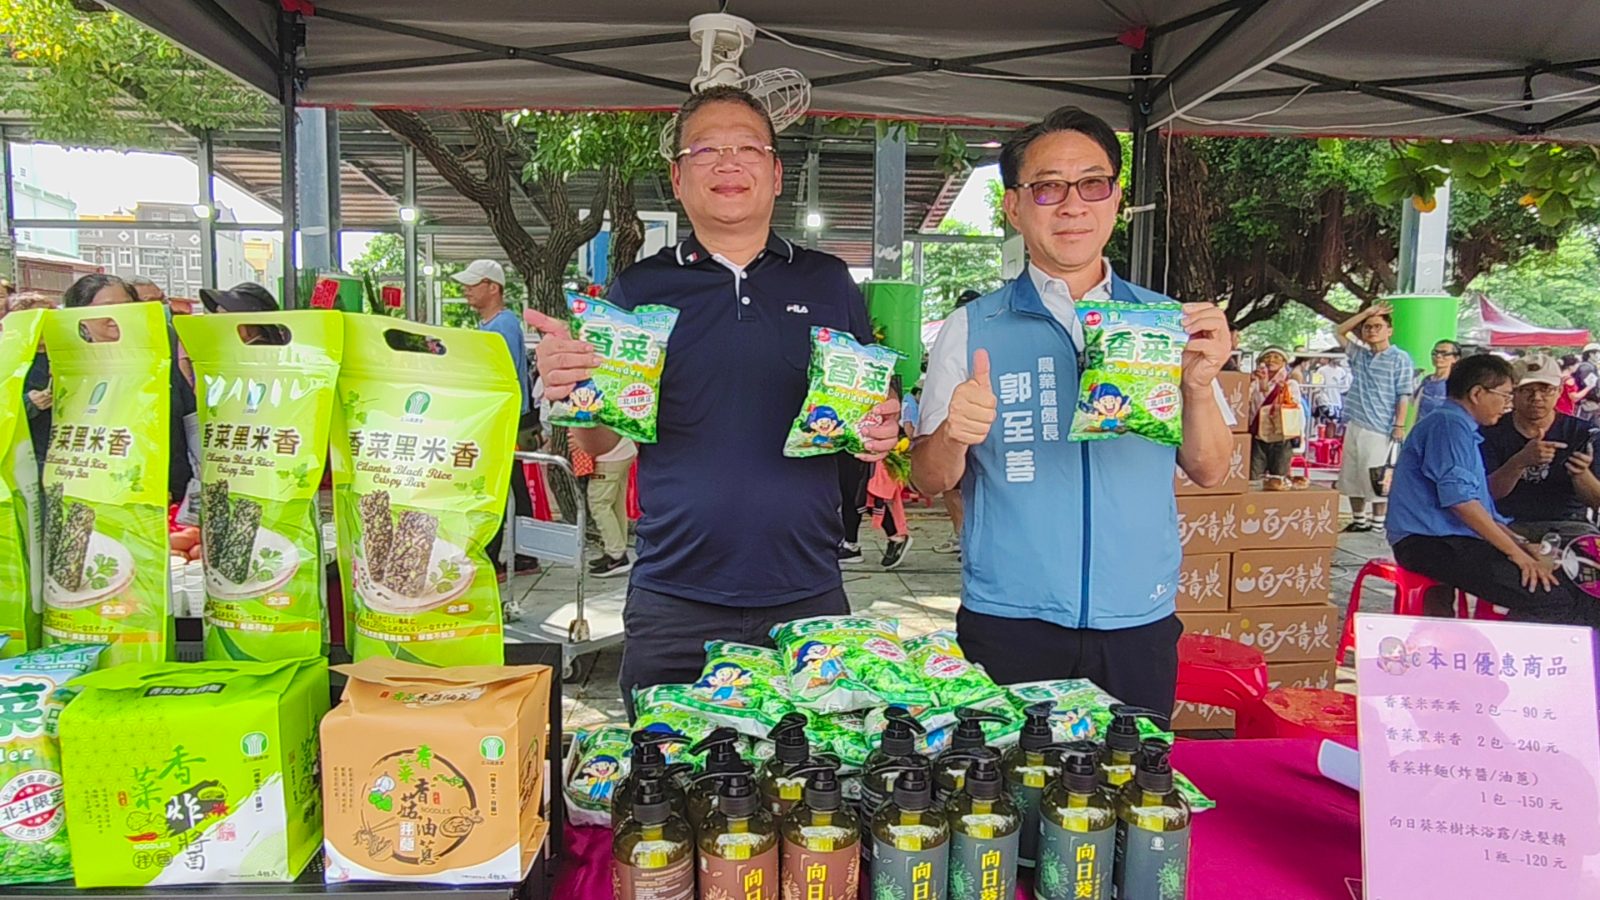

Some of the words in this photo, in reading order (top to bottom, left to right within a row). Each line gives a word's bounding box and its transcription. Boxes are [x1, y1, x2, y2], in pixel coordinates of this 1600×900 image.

[787, 304, 809, 313] FILA
[1105, 330, 1172, 362] 香菜
[829, 355, 890, 394] 香菜
[1106, 364, 1169, 378] Coriander
[999, 371, 1036, 482] 郭至善
[349, 429, 479, 468] 香菜黑米香
[356, 460, 392, 474] Cilantro
[393, 464, 424, 478] Black
[426, 467, 453, 481] Rice
[372, 472, 402, 488] Crispy
[404, 476, 427, 489] Bar
[1426, 646, 1568, 679] 本日優惠商品
[1384, 694, 1462, 713] 香菜米乖乖
[1385, 727, 1463, 747] 香菜黑米香
[398, 745, 432, 783] 香菜
[2, 788, 63, 822] 北斗限定
[912, 861, 932, 900] 向日
[1076, 843, 1096, 899] 向日葵
